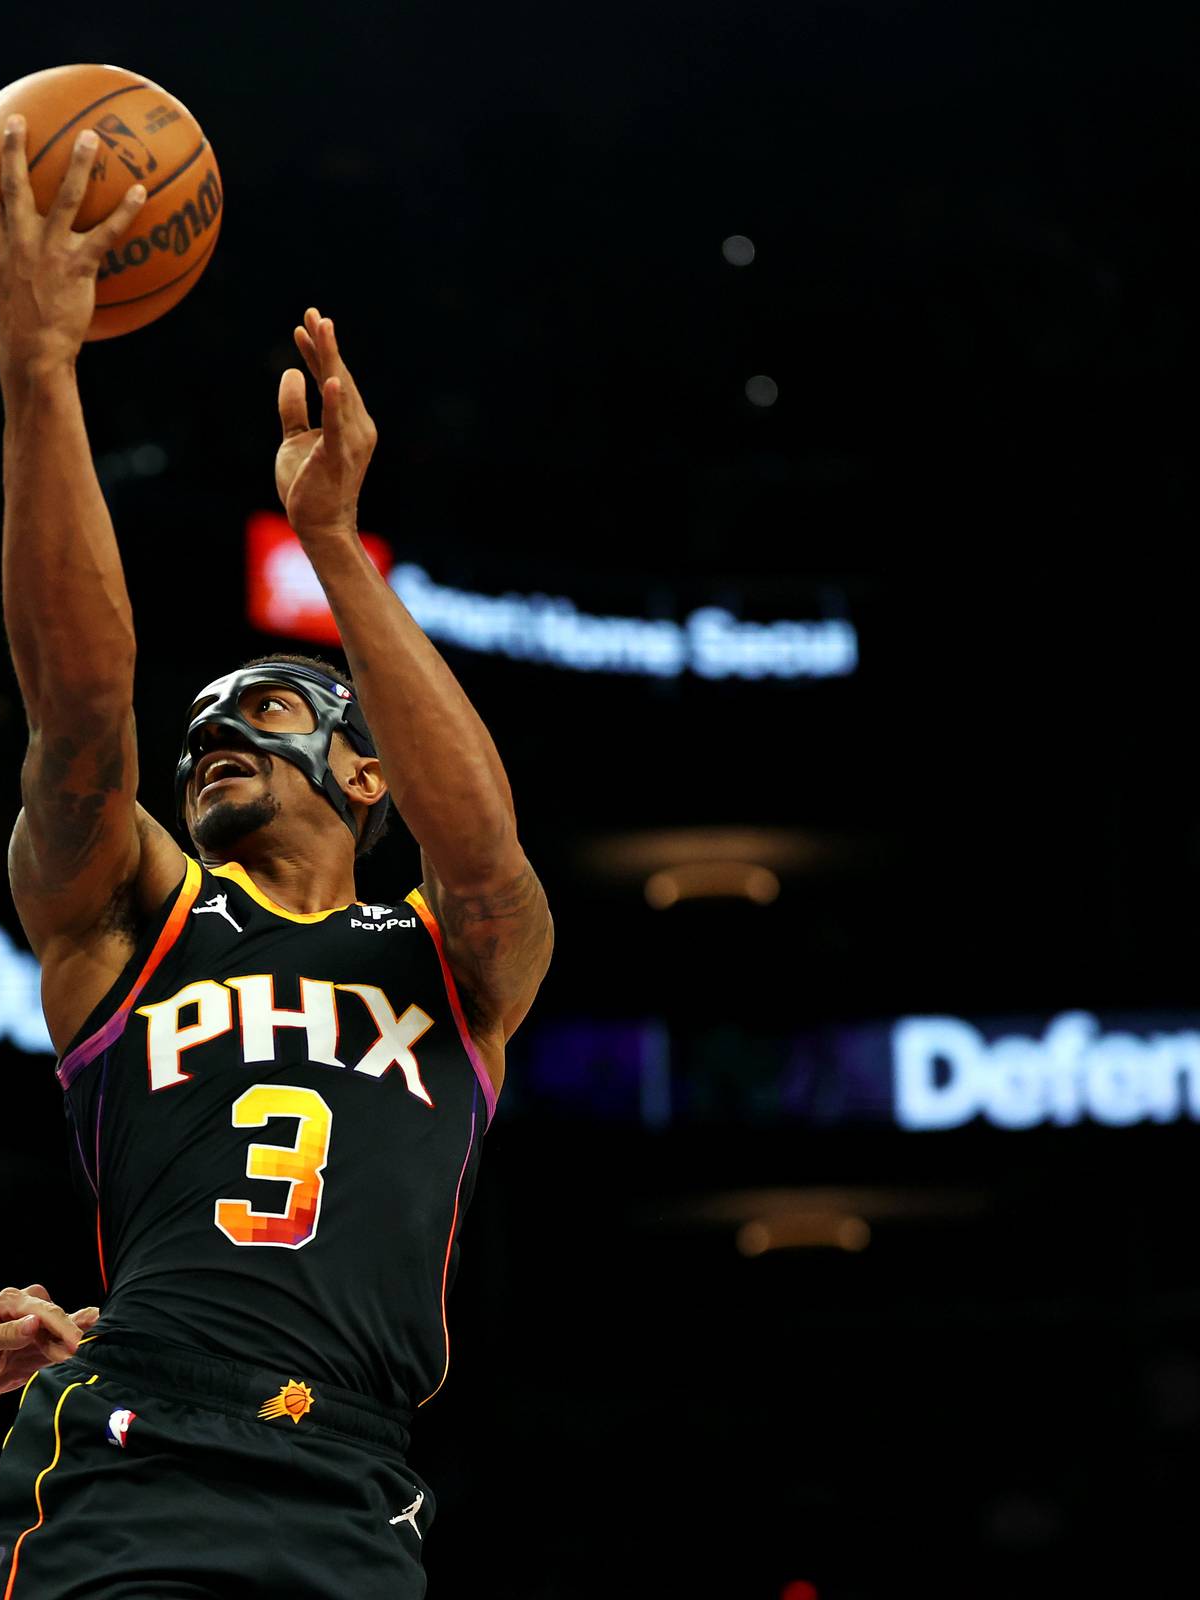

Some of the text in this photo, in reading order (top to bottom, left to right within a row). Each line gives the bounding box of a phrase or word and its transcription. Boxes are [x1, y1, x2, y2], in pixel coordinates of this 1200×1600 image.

[524, 592, 684, 678] Home
[350, 917, 416, 932] PayPal
[135, 973, 436, 1108] PHX
[214, 1084, 333, 1250] 3
